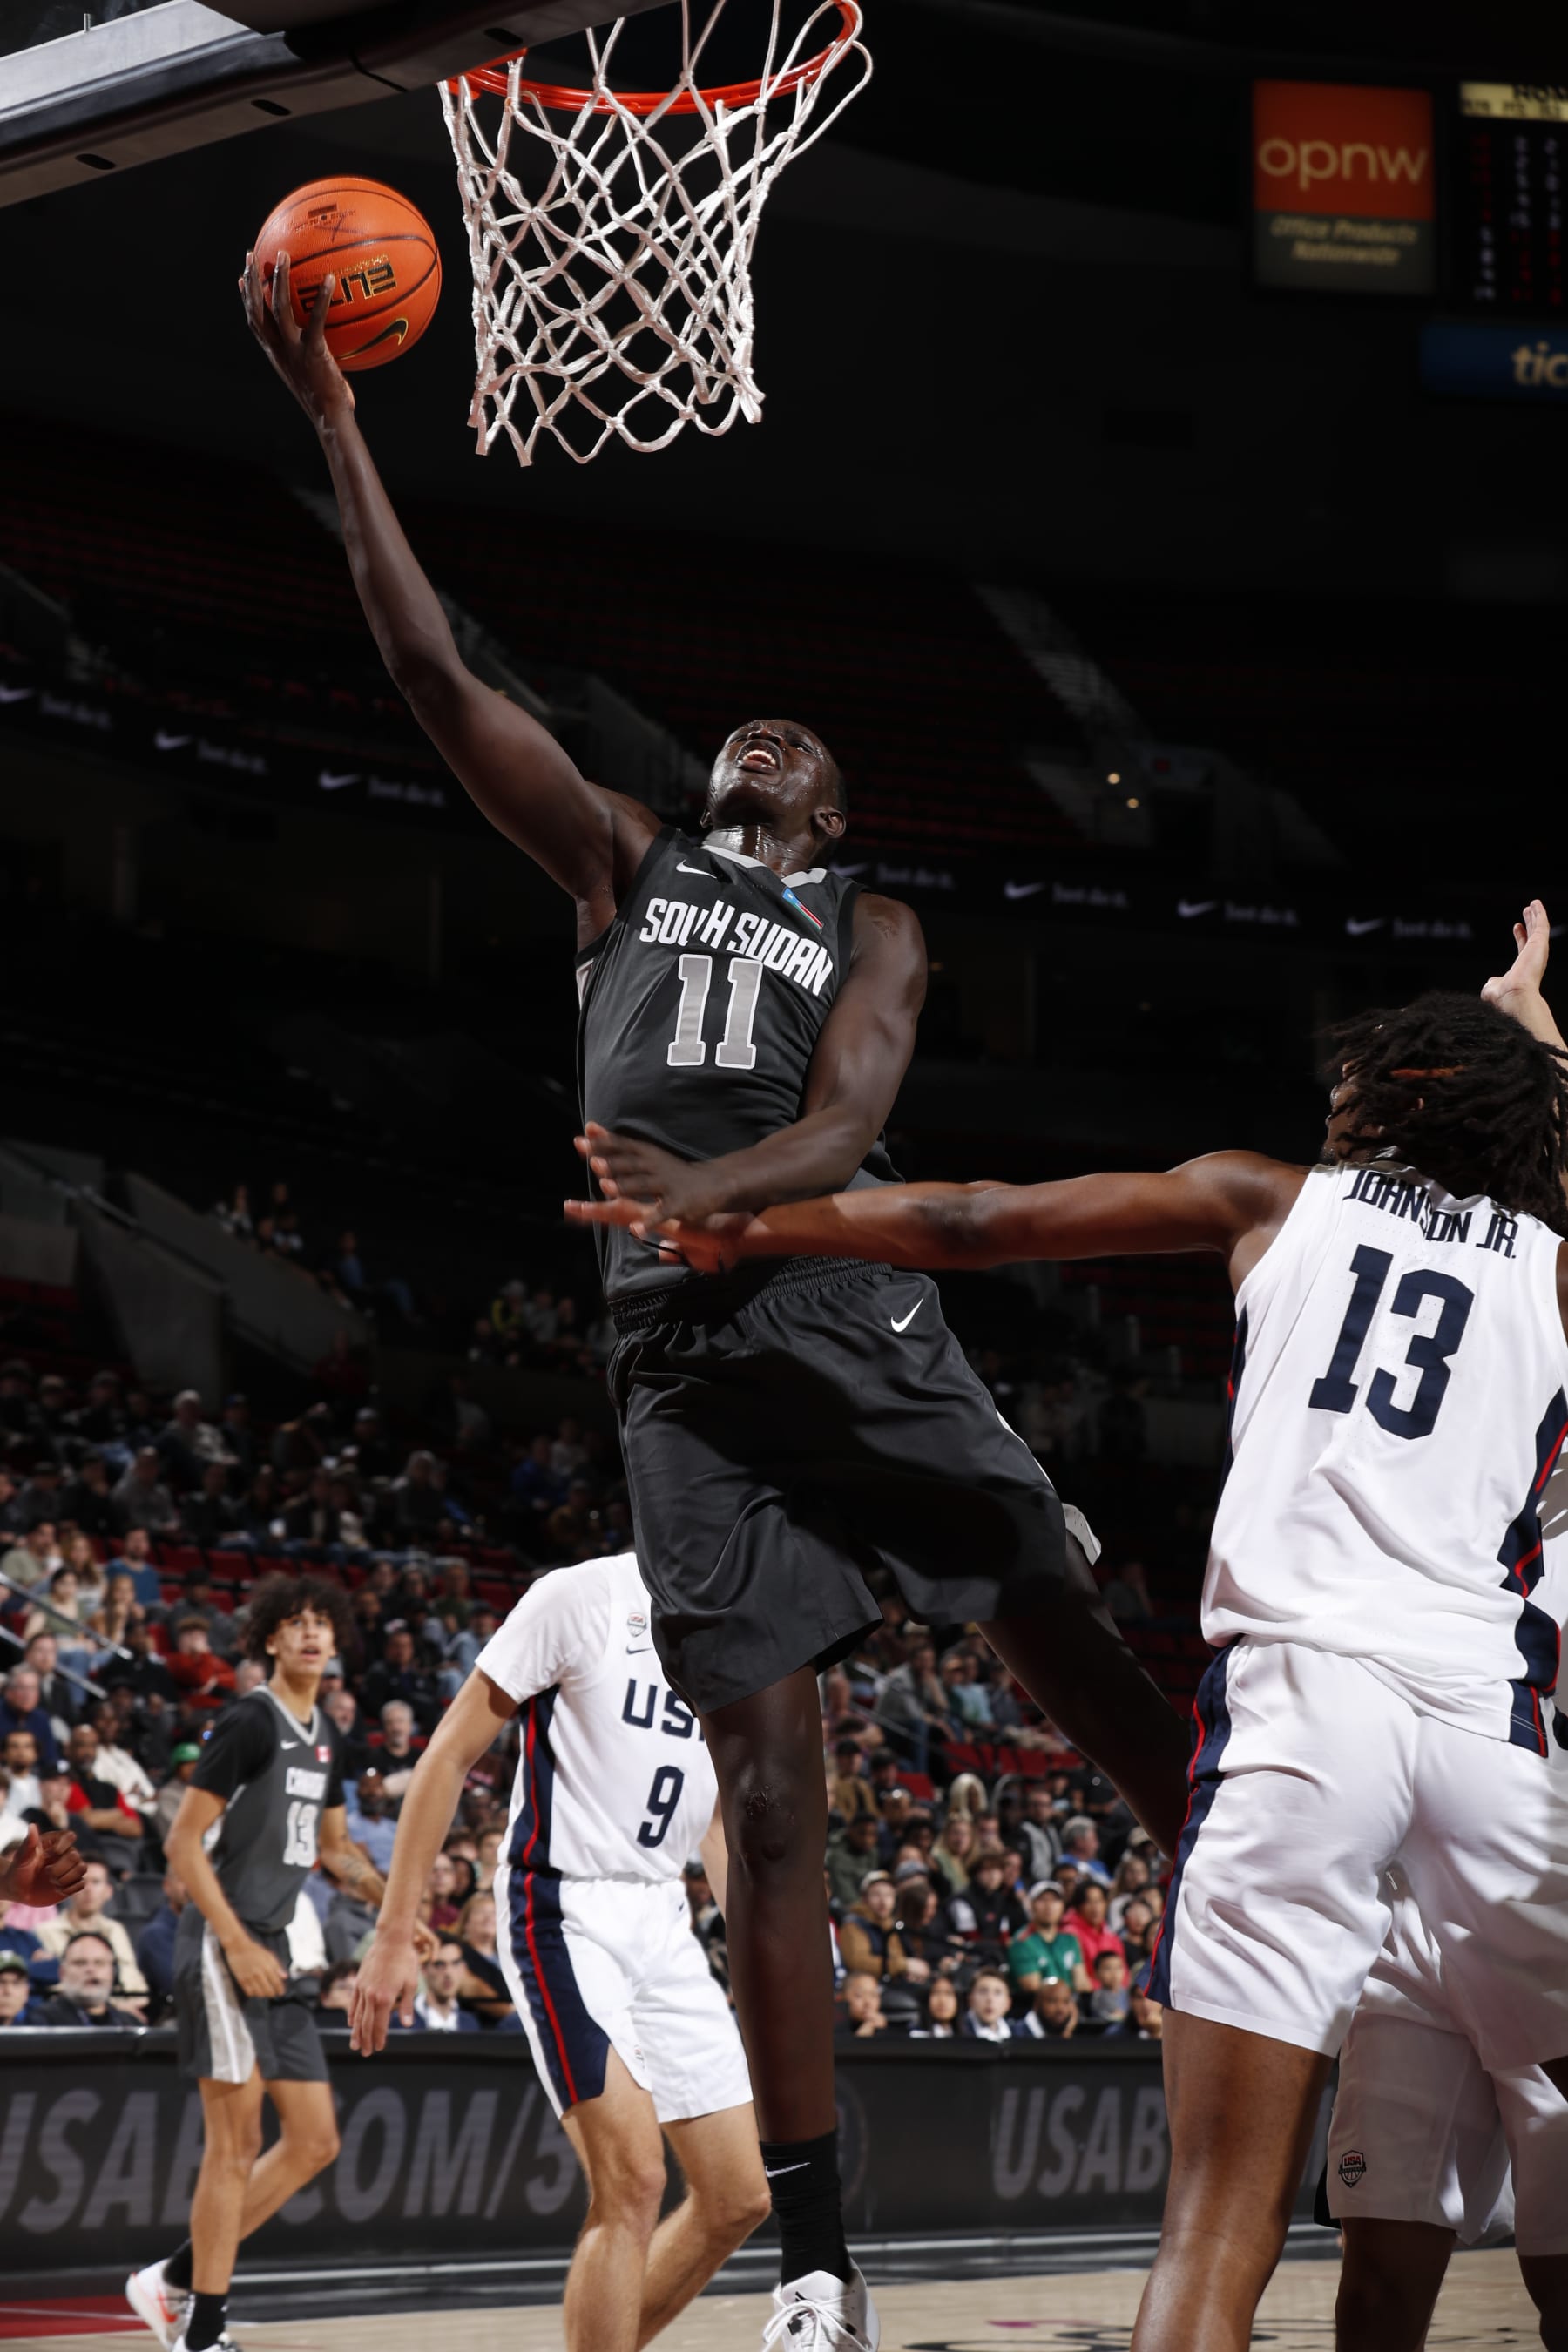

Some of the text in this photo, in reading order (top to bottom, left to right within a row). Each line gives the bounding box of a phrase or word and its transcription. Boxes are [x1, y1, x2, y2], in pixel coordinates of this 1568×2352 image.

[1258, 137, 1429, 192] opnw
[727, 912, 833, 997] SUDAN
[666, 953, 764, 1070] 11
[1475, 1213, 1519, 1259] JR.
[1308, 1244, 1475, 1440] 13
[621, 1678, 705, 1742] US
[282, 1801, 319, 1867] 13
[636, 1765, 685, 1848] 9
[1344, 2155, 1361, 2166] USA
